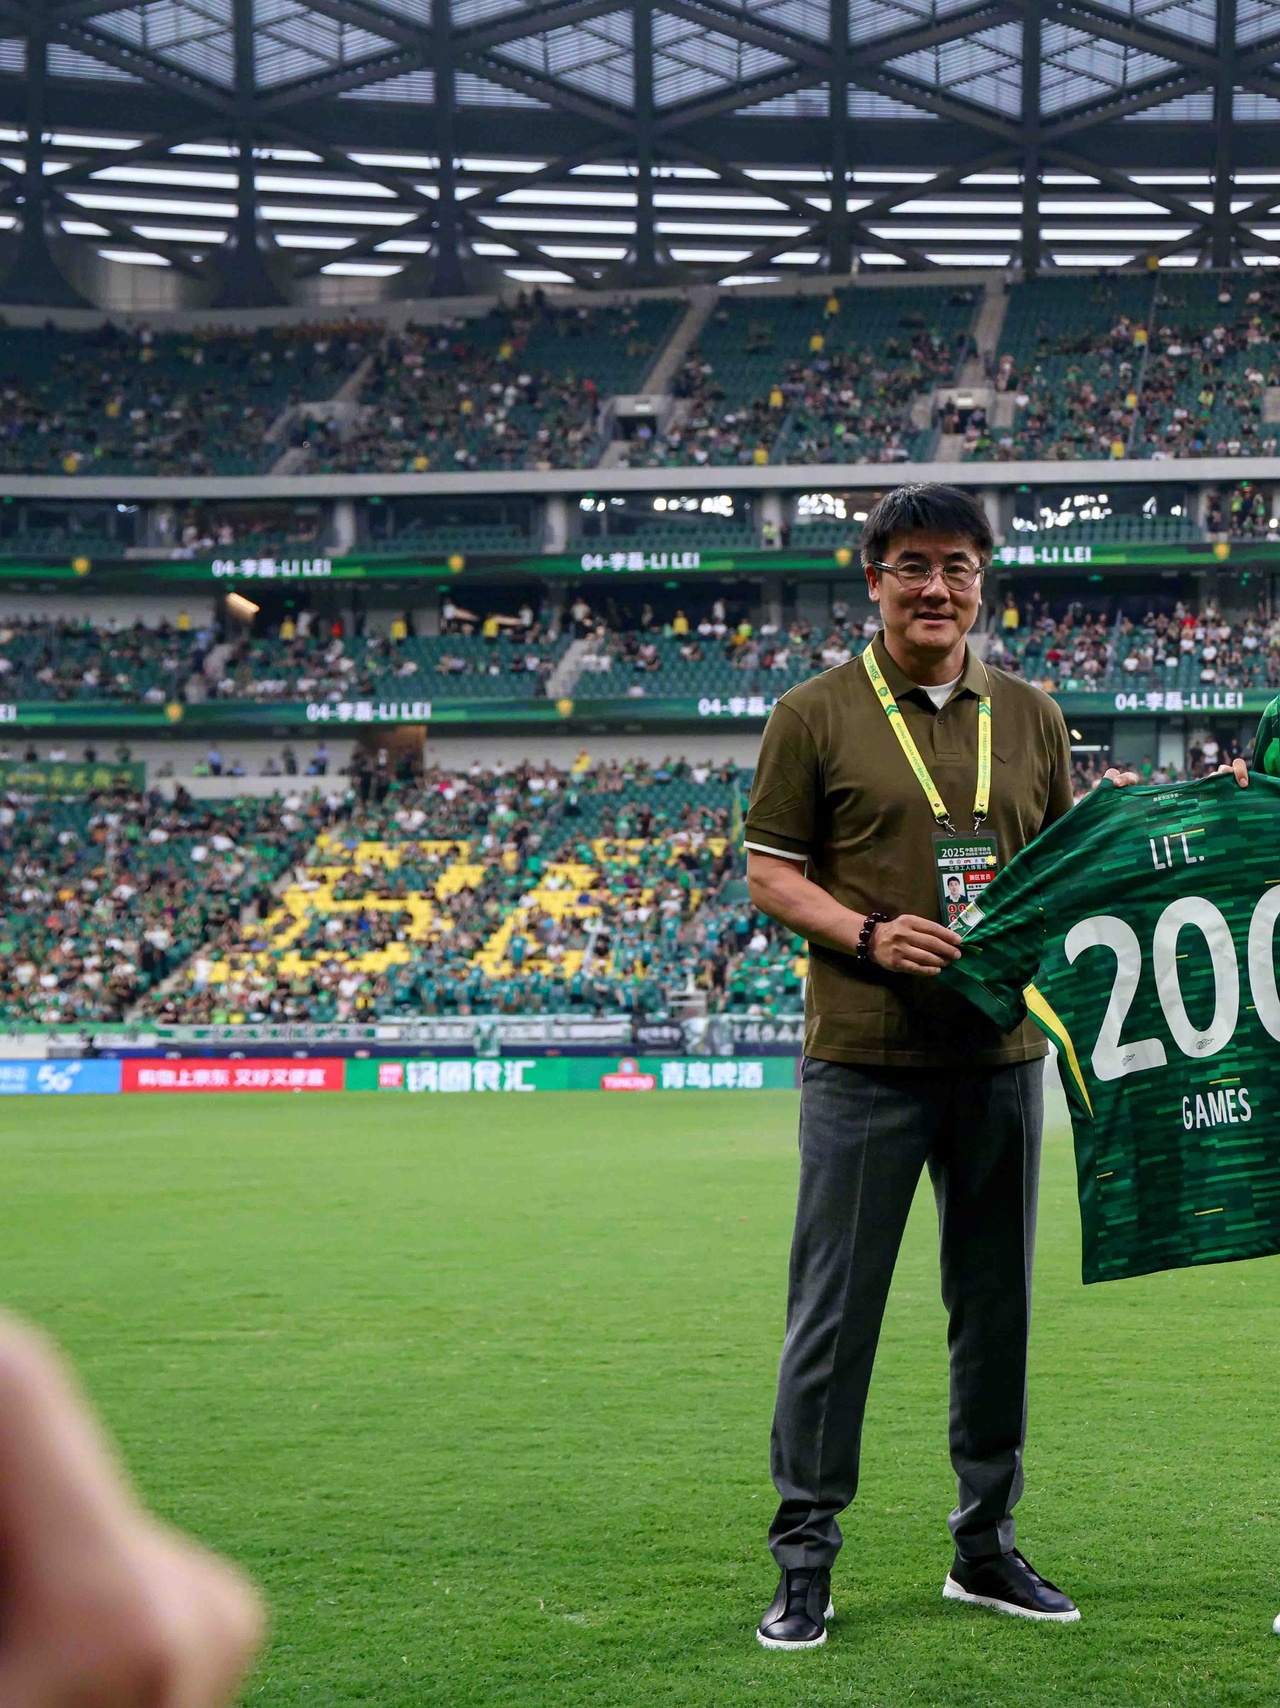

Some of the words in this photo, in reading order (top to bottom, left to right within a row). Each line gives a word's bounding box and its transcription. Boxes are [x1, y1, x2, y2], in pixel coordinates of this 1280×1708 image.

[1062, 546, 1091, 563] LEI
[1213, 692, 1243, 709] LEI
[941, 847, 965, 858] 2025
[1149, 835, 1173, 870] LI
[1180, 832, 1205, 864] L.
[406, 1060, 537, 1092] 锅圈食汇
[661, 1061, 763, 1089] 青岛啤酒
[1182, 1088, 1252, 1130] GAMES
